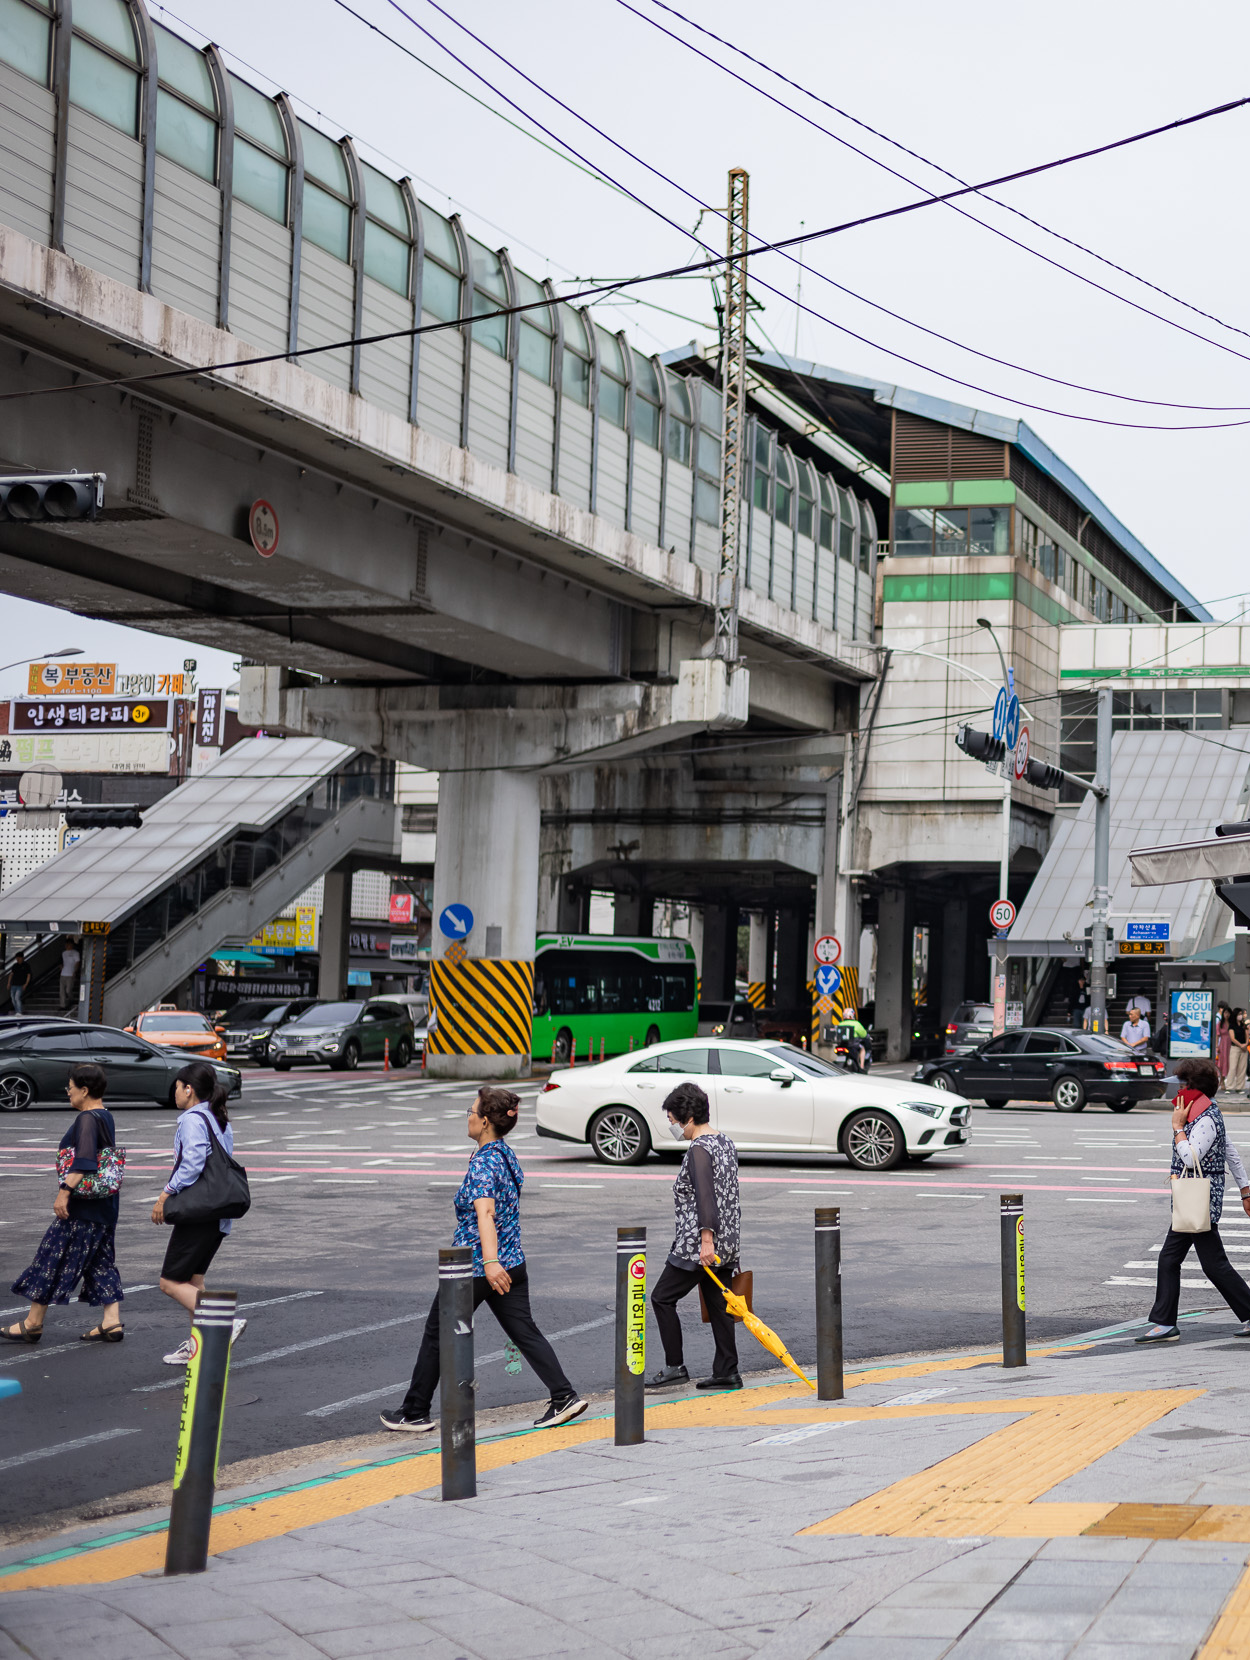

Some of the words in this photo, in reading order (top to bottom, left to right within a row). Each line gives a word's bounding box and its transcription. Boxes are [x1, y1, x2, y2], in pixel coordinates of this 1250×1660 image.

[184, 661, 195, 670] 3F
[44, 668, 59, 684] 복
[64, 667, 113, 686] 부동산
[118, 674, 155, 697] 고양이
[157, 673, 184, 695] 카페
[27, 704, 129, 726] 인생테라피
[202, 695, 216, 737] 마사지
[1017, 741, 1027, 765] 50
[995, 907, 1011, 921] 50
[265, 925, 295, 941] 부동산
[1185, 992, 1210, 1001] VISIT
[1180, 1002, 1211, 1011] SEOUL
[1185, 1011, 1207, 1020] NET
[631, 1284, 644, 1357] 금연구역
